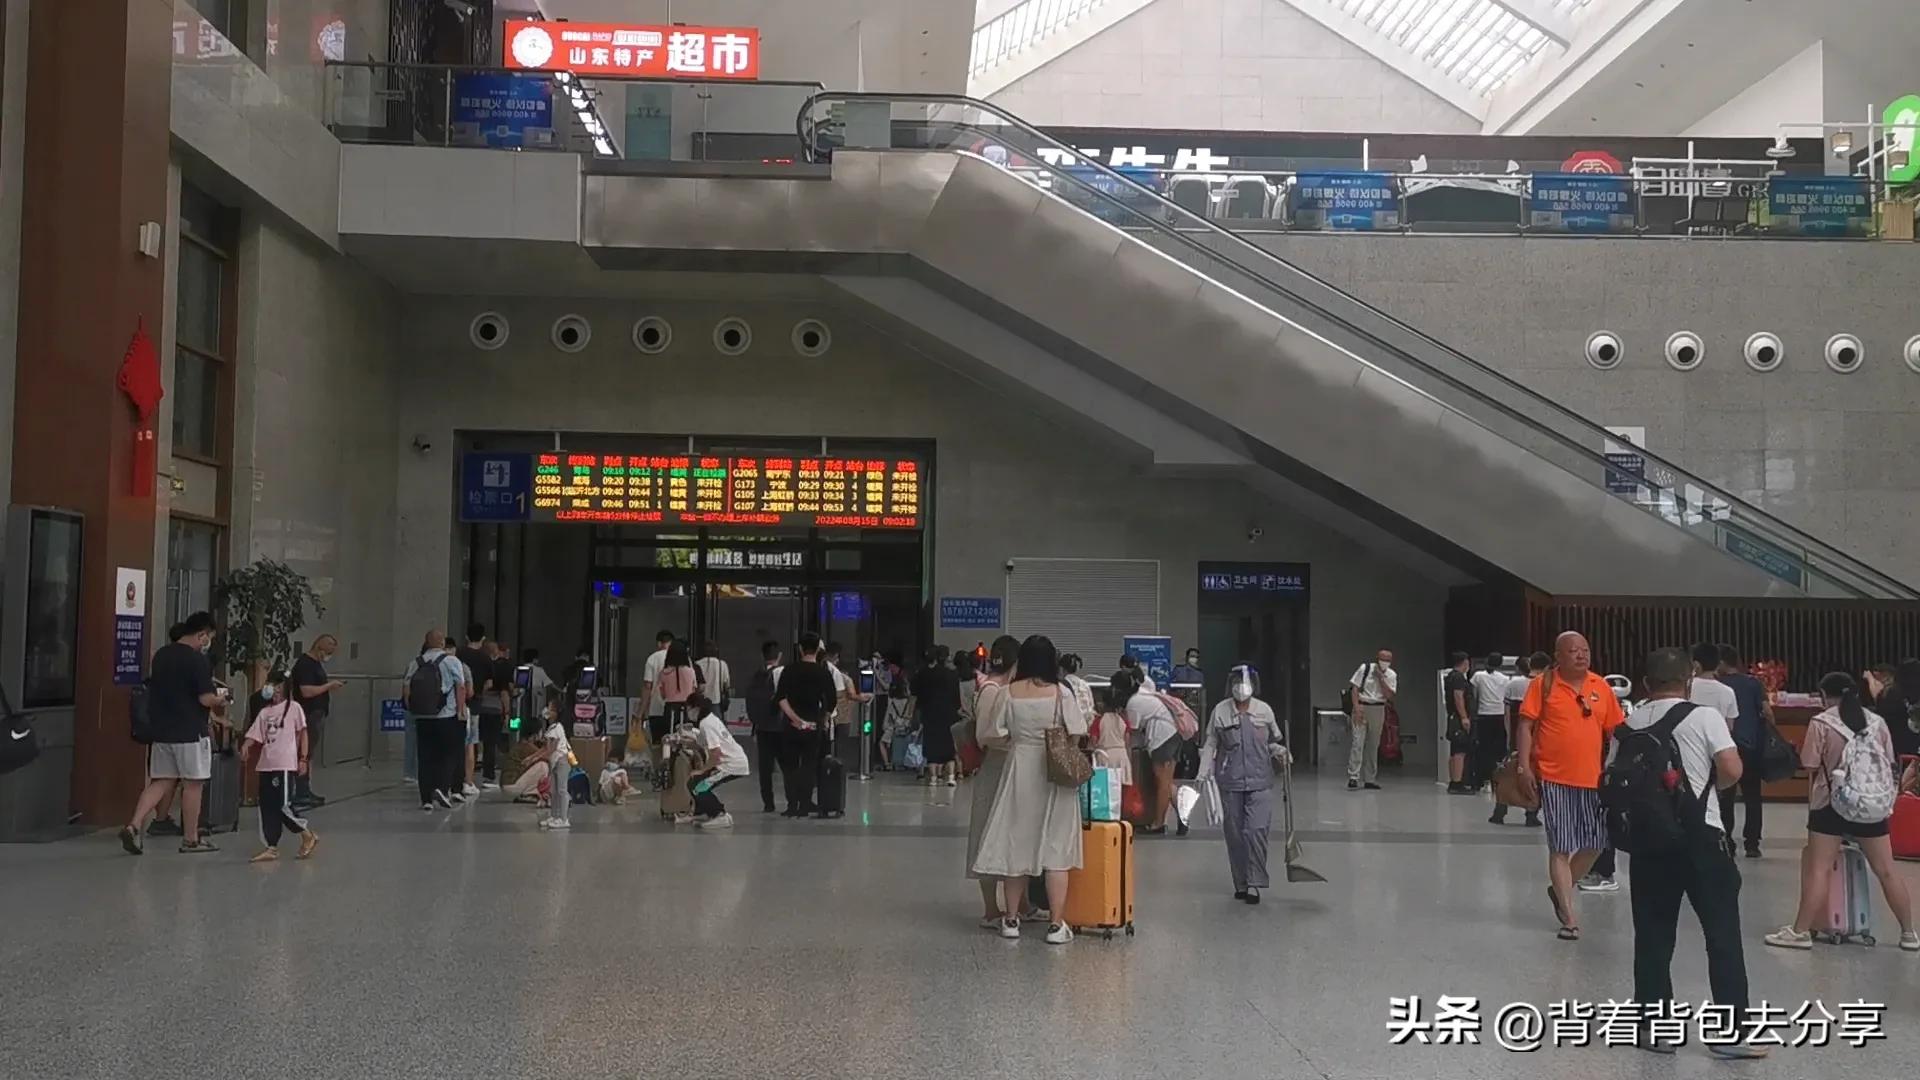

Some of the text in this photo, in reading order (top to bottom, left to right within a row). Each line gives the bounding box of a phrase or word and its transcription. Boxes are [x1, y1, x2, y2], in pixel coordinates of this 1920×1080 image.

[569, 47, 654, 67] 山东特产
[666, 31, 750, 74] 超市
[537, 466, 559, 474] G246
[629, 468, 650, 476] 09:12
[733, 469, 758, 478] G2065
[799, 471, 819, 479] 09:19
[823, 471, 844, 479] 09:21
[535, 475, 561, 484] G5582
[602, 477, 624, 485] 09:20
[657, 478, 663, 486] 9
[697, 478, 722, 488] 未开检
[735, 480, 755, 488] G173
[770, 481, 787, 490] 宁波
[798, 482, 819, 490] 09:29
[823, 482, 844, 490] 09:30
[852, 482, 857, 490] 4
[892, 483, 917, 492] 未开检
[535, 486, 561, 495] G5566
[602, 487, 624, 496] 09:40
[628, 488, 650, 496] 09:44
[697, 489, 722, 499] 未开检
[735, 490, 755, 499] G105
[761, 491, 794, 500] 上海虹桥
[798, 491, 819, 500] 09:33
[823, 492, 844, 500] 09:34
[852, 492, 857, 500] 3
[891, 492, 917, 502] 未开检
[469, 489, 526, 514] 检票口 1
[534, 498, 560, 507] G6974
[602, 500, 623, 508] 09:46
[628, 500, 649, 509] 09:51
[657, 501, 662, 509] 1
[696, 501, 722, 511] 未开检
[734, 502, 755, 511] G107
[761, 502, 794, 512] 上海虹桥
[798, 503, 819, 511] 09:44
[823, 504, 844, 512] 09:53
[851, 504, 857, 512] 4
[891, 504, 917, 514] 未开检
[1233, 575, 1302, 585] 卫生间 饮水处
